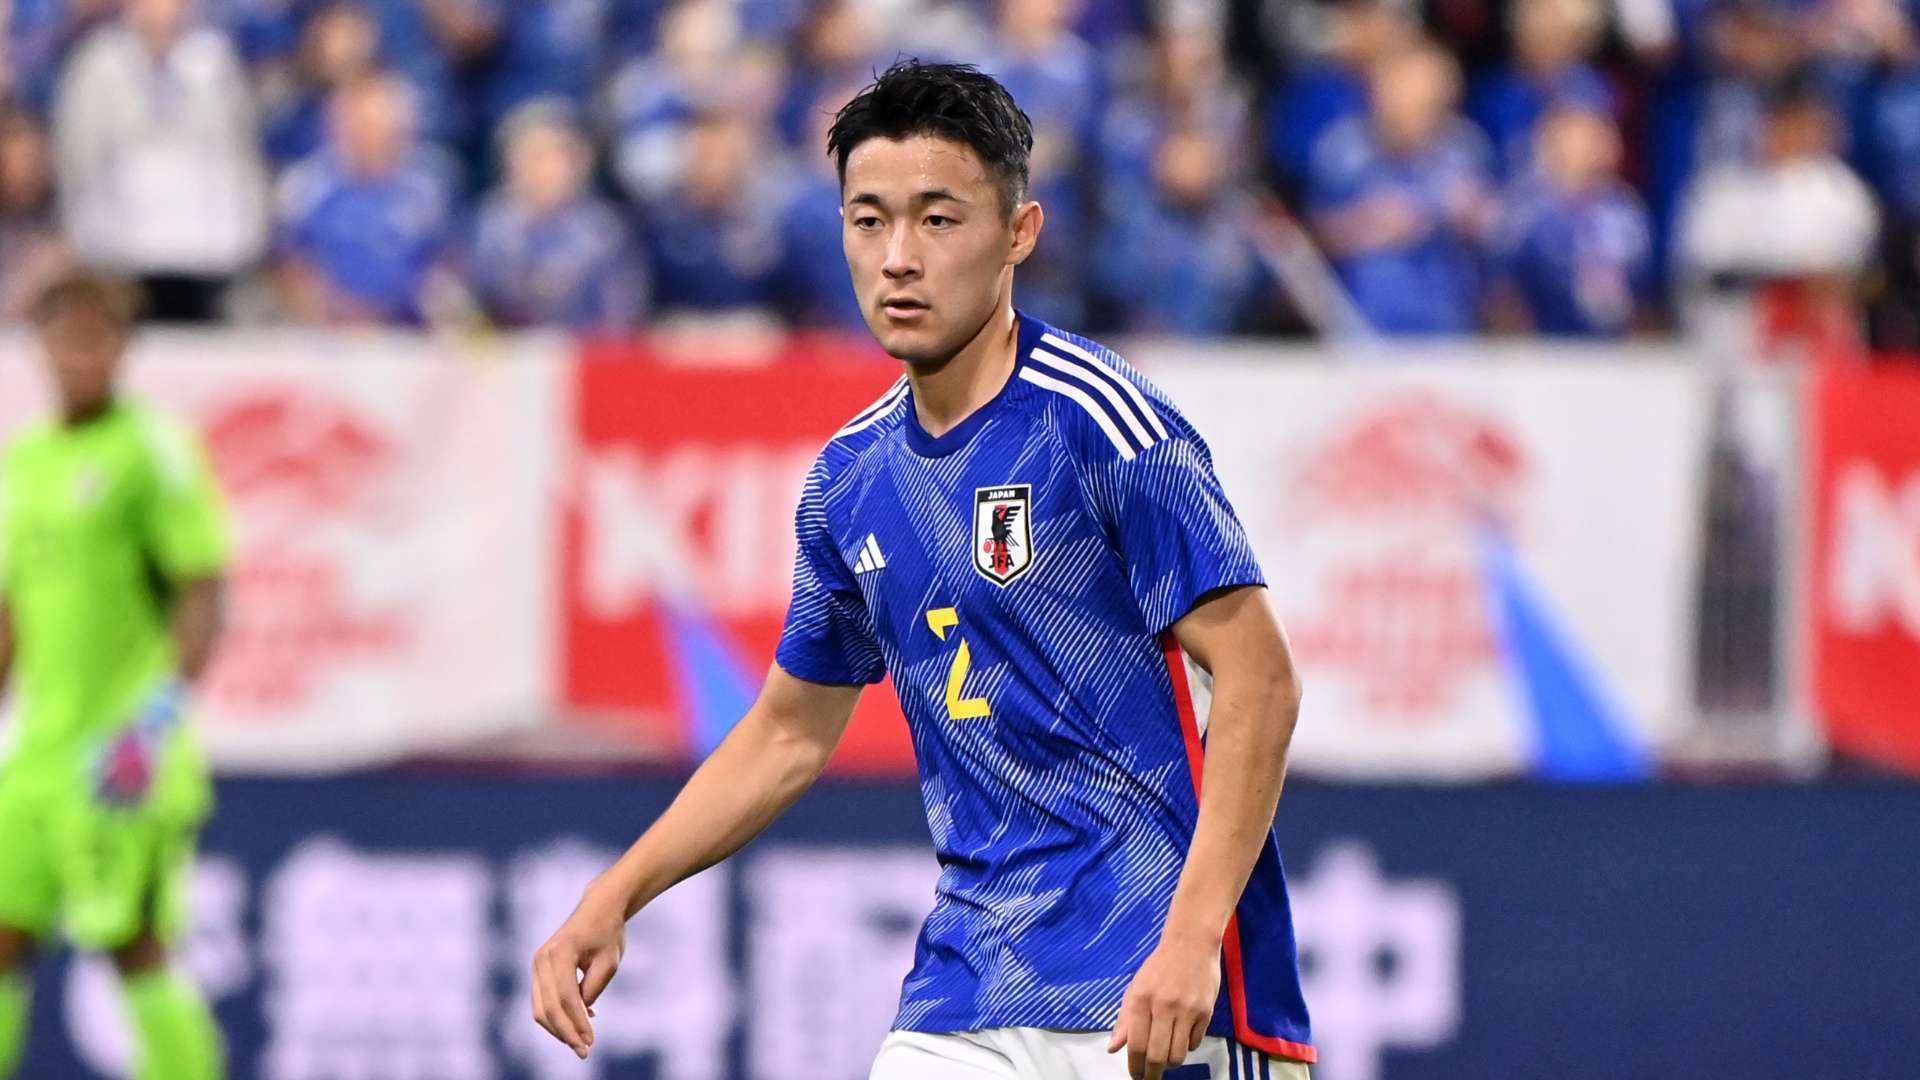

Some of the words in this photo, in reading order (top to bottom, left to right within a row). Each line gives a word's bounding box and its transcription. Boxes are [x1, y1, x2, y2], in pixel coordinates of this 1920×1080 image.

[988, 490, 1015, 499] JAPAN
[988, 553, 1015, 569] JFA
[926, 607, 991, 720] 2
